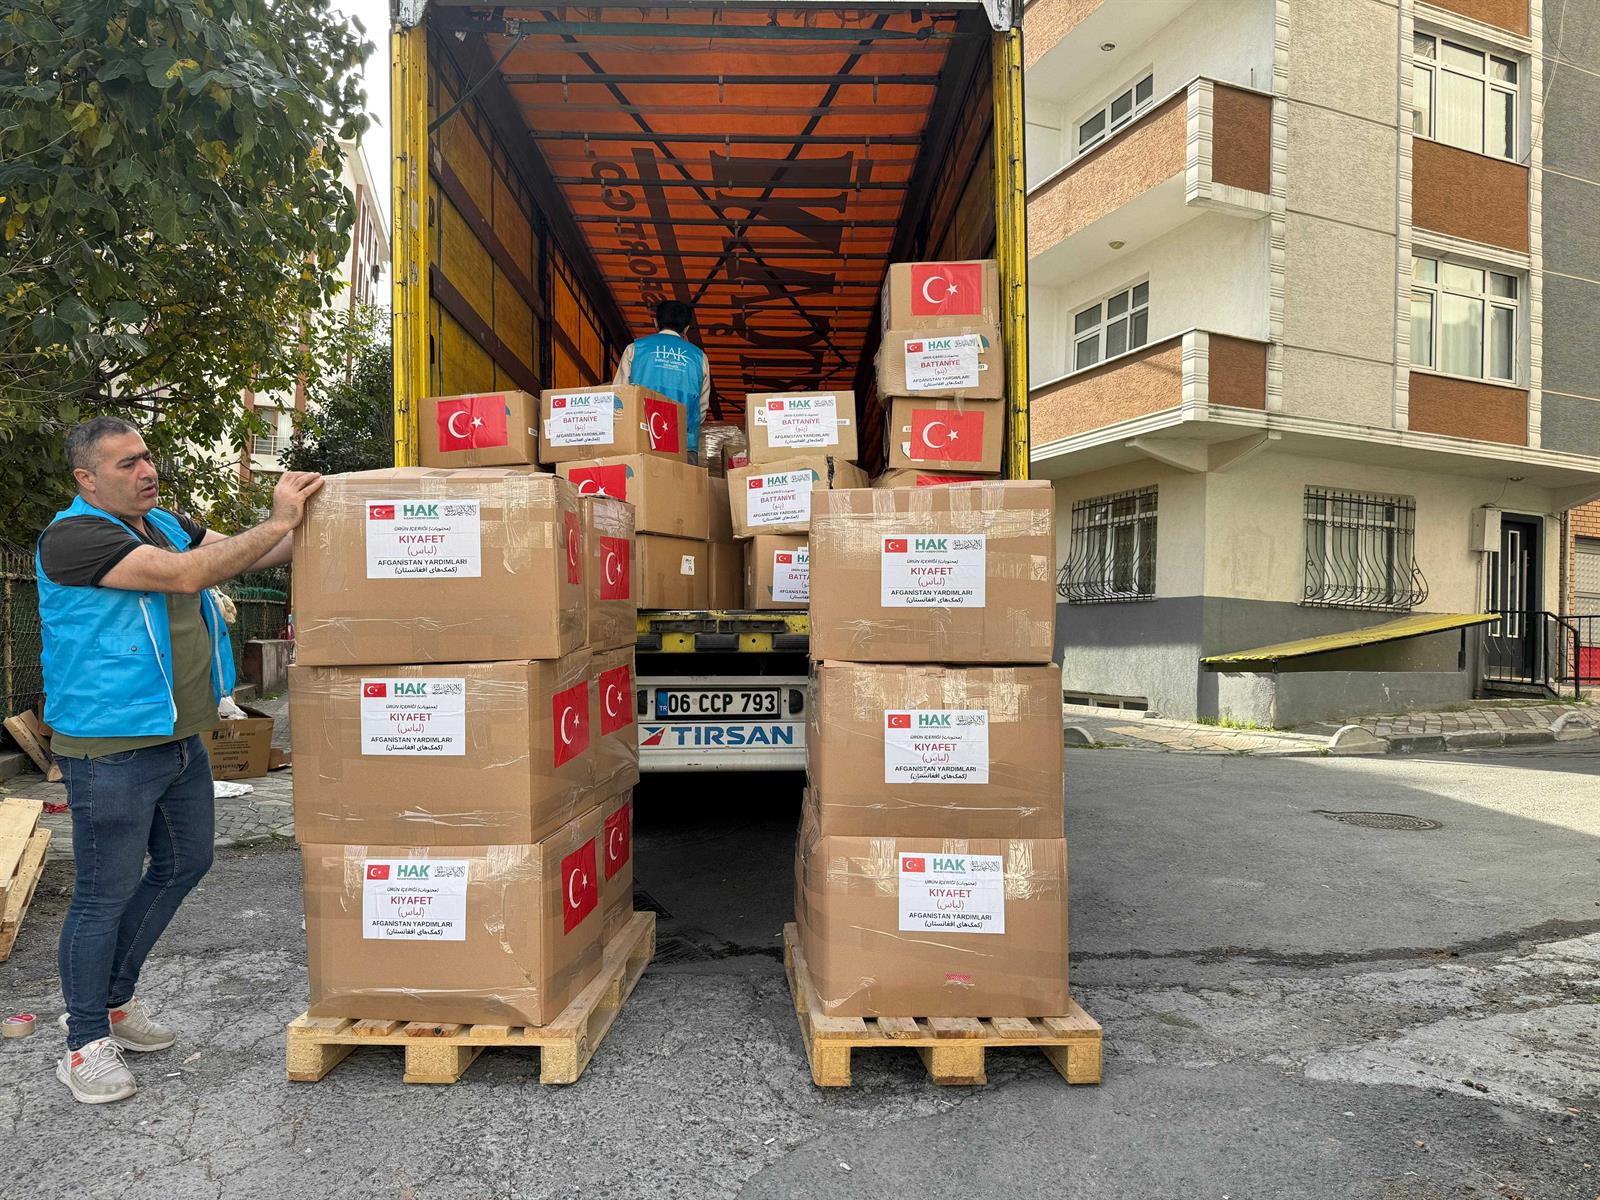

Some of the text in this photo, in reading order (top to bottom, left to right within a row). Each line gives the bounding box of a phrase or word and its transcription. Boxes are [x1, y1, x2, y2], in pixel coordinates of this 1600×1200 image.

[928, 340, 951, 349] HAK
[656, 346, 688, 363] HAK
[920, 359, 960, 368] BATTANİYE
[571, 397, 590, 405] HAK
[789, 400, 810, 408] HAK
[768, 476, 787, 484] HAK
[403, 505, 438, 516] HAK
[399, 535, 445, 543] KIYAFET
[915, 539, 947, 549] HAK
[394, 683, 427, 694] HAK
[669, 694, 690, 712] 06
[699, 694, 733, 712] CCP
[741, 694, 775, 712] 793
[390, 713, 432, 721] KIYAFET
[919, 714, 950, 725] HAK
[671, 726, 792, 745] TIRSAN
[933, 859, 965, 870] HAK
[397, 865, 430, 877] HAK
[929, 889, 971, 897] KIYAFET
